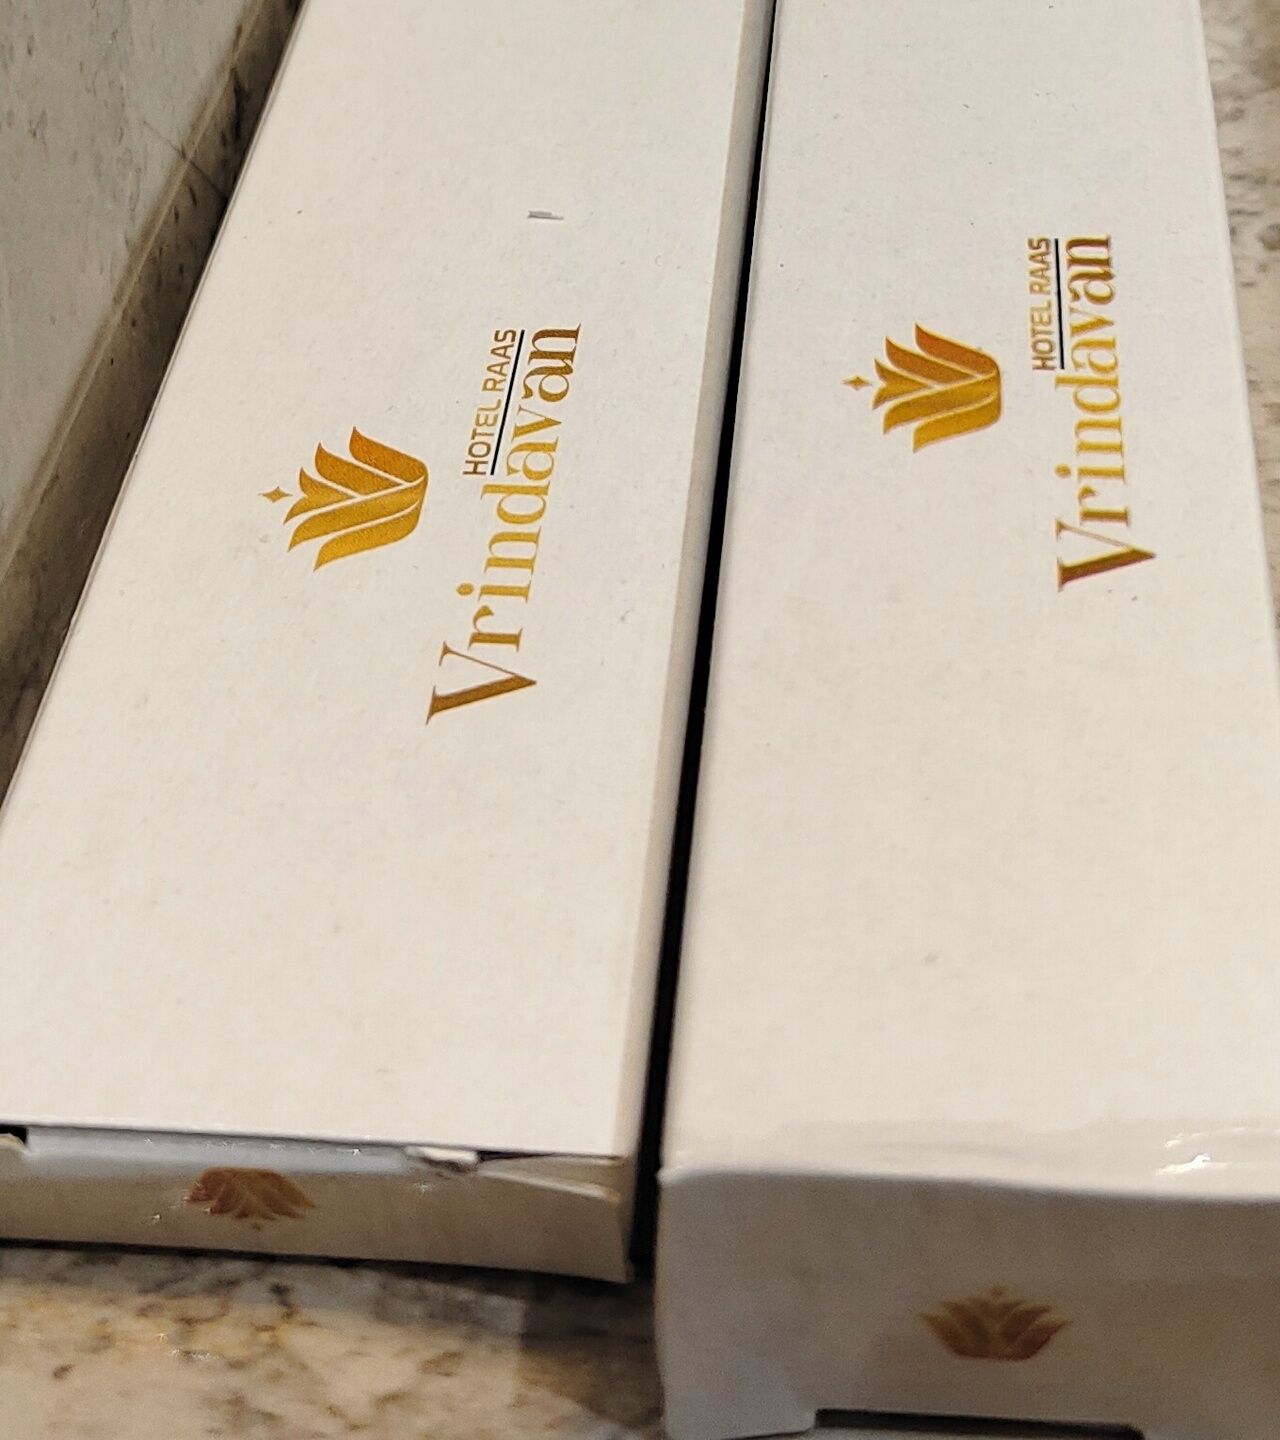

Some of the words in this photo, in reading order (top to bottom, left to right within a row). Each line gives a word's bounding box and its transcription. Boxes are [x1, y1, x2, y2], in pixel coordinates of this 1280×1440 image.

[1027, 236, 1053, 297] RAAS
[481, 328, 517, 393] RAAS
[1030, 302, 1058, 372] HOTEL
[462, 398, 502, 477] HOTEL
[1054, 233, 1157, 593] Vrindavan
[425, 322, 582, 727] Vrindavan
